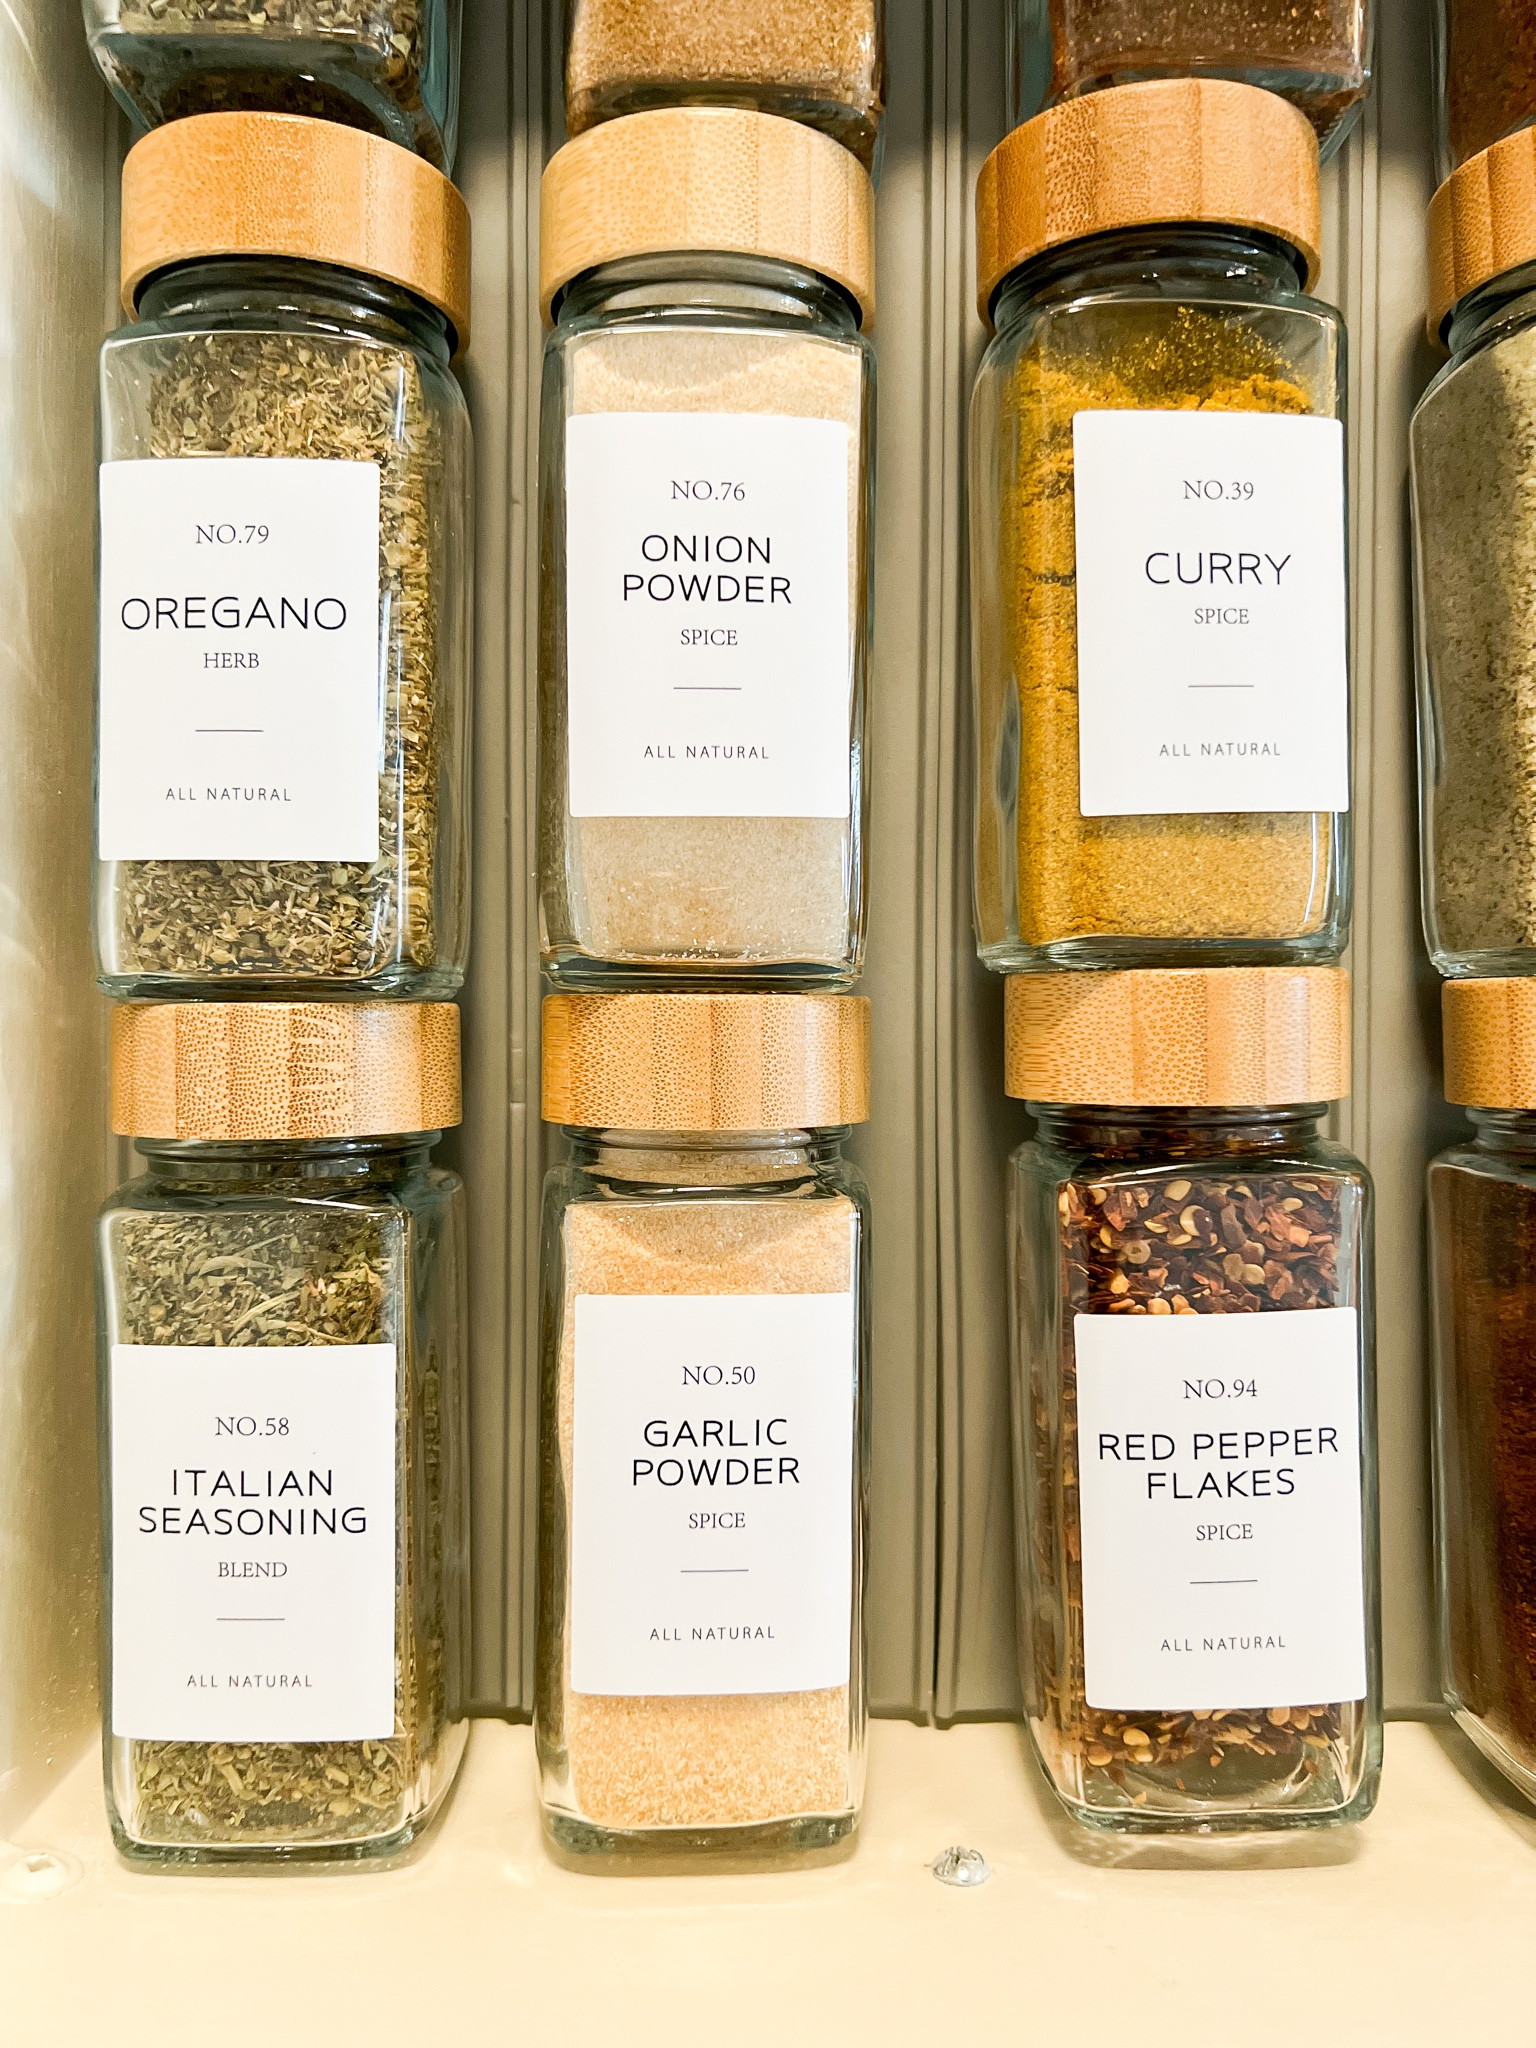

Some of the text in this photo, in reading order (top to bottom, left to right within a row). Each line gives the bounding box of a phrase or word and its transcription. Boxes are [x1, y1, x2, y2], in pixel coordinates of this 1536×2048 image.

[670, 480, 746, 502] NO.76
[1182, 480, 1254, 501] NO.39
[195, 523, 270, 545] NO.79
[641, 534, 771, 565] ONION
[1144, 551, 1292, 586] CURRY
[623, 573, 792, 605] POWDER
[120, 595, 347, 631] OREGANO
[1194, 607, 1250, 625] SPICE
[680, 628, 739, 646] SPICE
[203, 652, 260, 669] HERB
[643, 745, 769, 760] ALL NATURAL
[1159, 742, 1281, 757] ALL NATURAL
[165, 787, 292, 802] ALL NATURAL
[681, 1365, 756, 1386] NO.50
[1182, 1378, 1258, 1400] NO.94
[214, 1416, 290, 1437] NO.58
[643, 1418, 788, 1448] GARLIC
[1098, 1426, 1339, 1461] RED PEPPER
[632, 1456, 801, 1487] POWDER
[172, 1468, 333, 1498] ITALIAN
[1147, 1467, 1295, 1500] FLAKES
[138, 1505, 367, 1536] SEASONING
[688, 1512, 746, 1530] SPICE
[1195, 1523, 1254, 1542] SPICE
[218, 1561, 288, 1578] BLEND
[649, 1625, 775, 1641] ALL NATURAL
[1160, 1635, 1286, 1652] ALL NATURAL
[186, 1674, 313, 1688] ALL NATURAL
